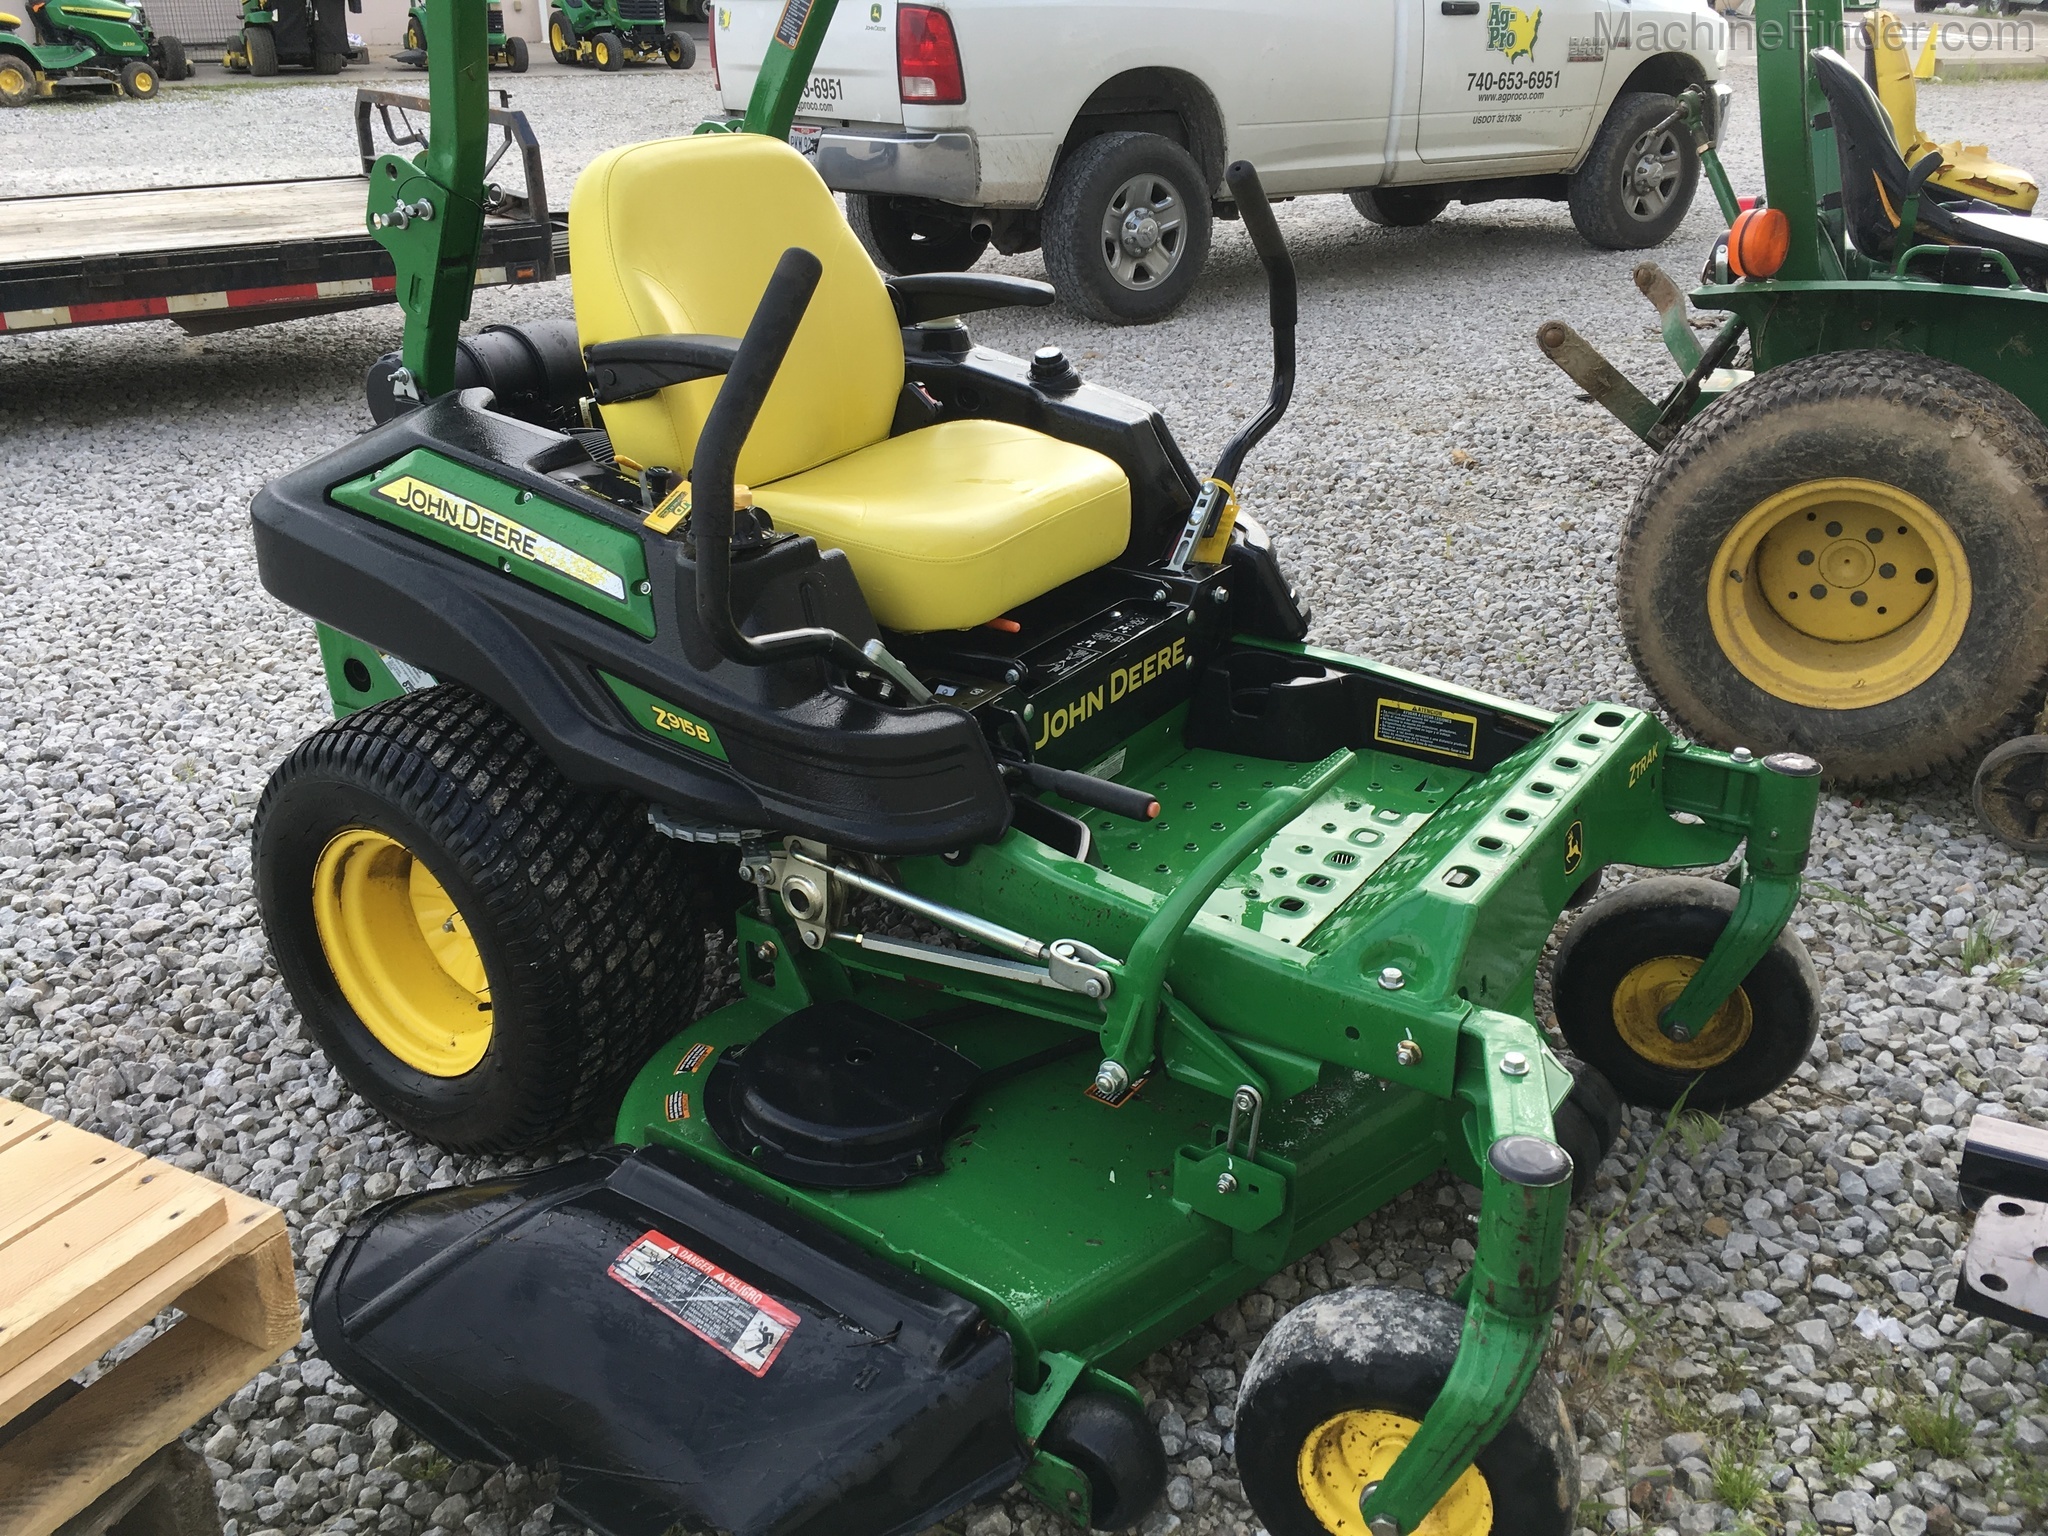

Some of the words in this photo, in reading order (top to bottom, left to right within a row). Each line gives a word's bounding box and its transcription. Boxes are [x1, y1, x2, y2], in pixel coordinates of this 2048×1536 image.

[1488, 4, 1516, 31] Ag-
[1488, 27, 1516, 50] Pro
[1569, 46, 1605, 56] 2500
[1467, 70, 1560, 91] 740-653-6951
[1478, 91, 1545, 103] www.agproco.com
[1472, 115, 1495, 124] USDOT
[399, 481, 459, 523] JOHN
[463, 504, 538, 558] DEERE
[1035, 684, 1104, 751] JOHN
[1110, 636, 1186, 704] DEERE
[651, 705, 711, 743] Z915B
[1628, 741, 1659, 789] ZTRAK
[679, 1250, 715, 1275] DANGER
[723, 1276, 764, 1305] PELIGRO
